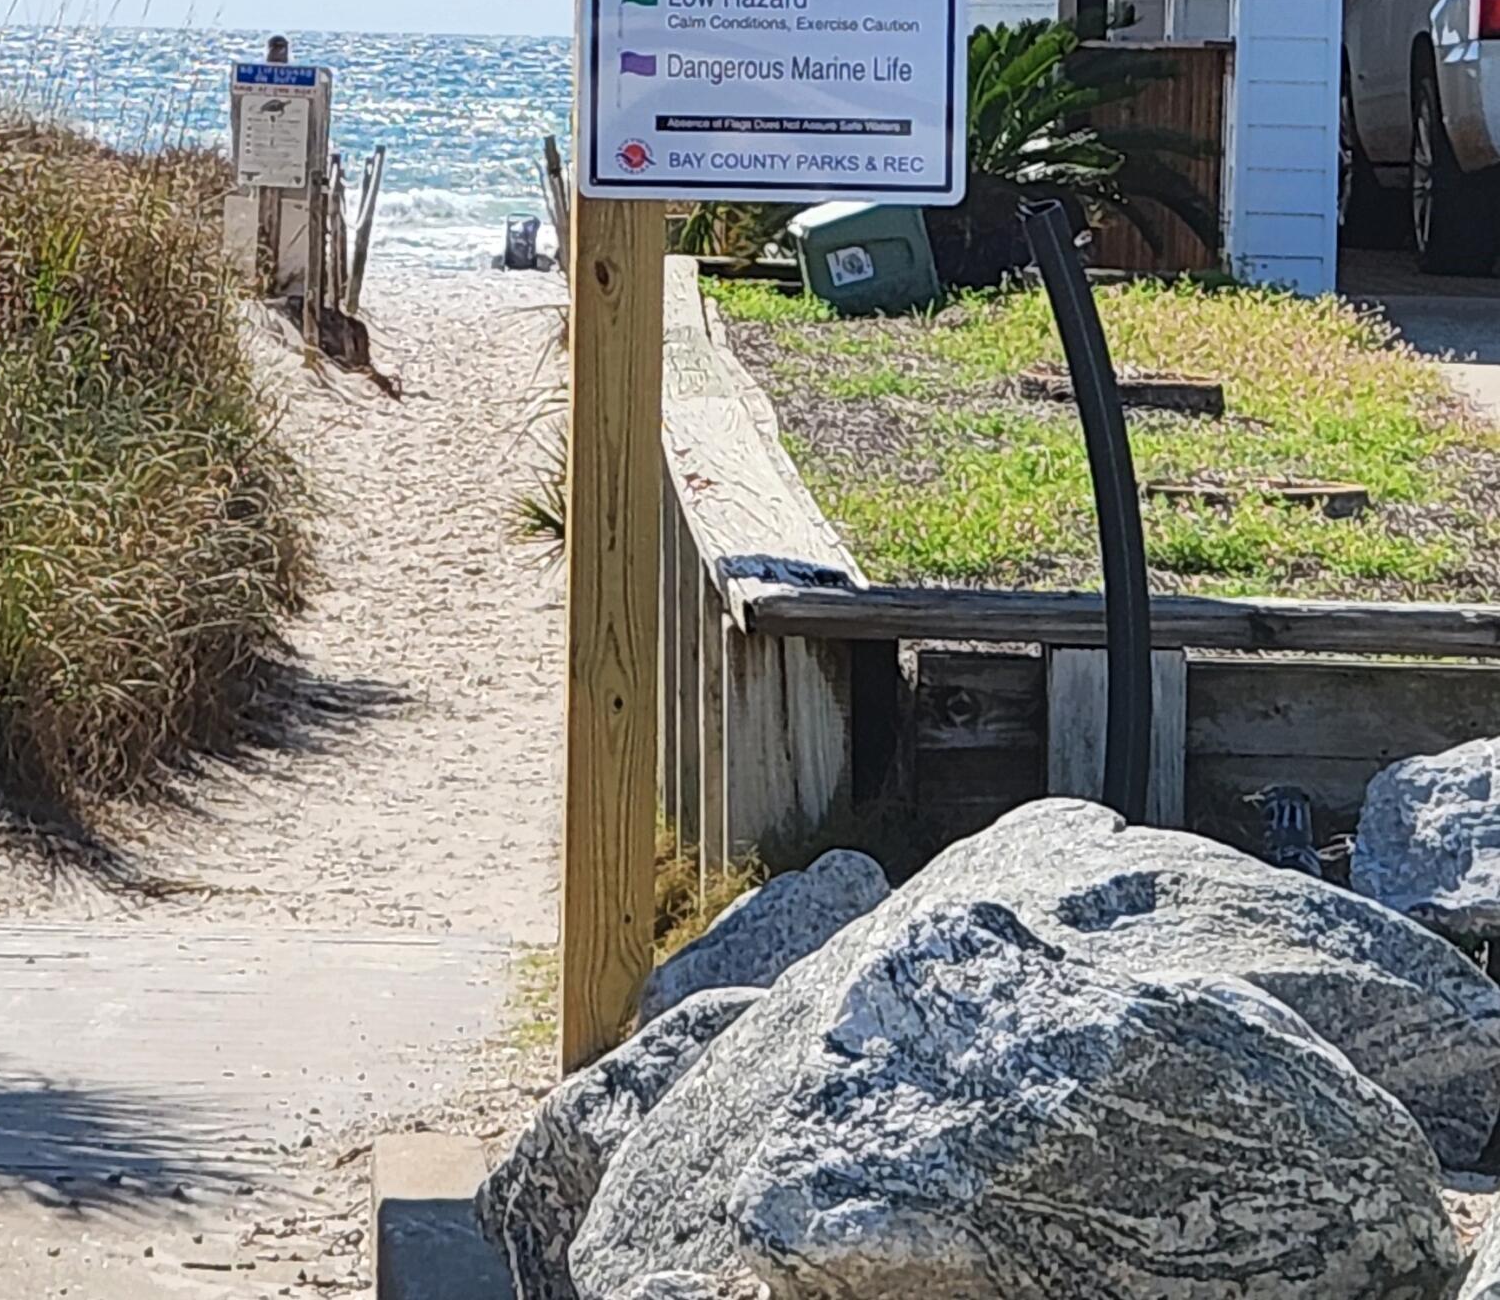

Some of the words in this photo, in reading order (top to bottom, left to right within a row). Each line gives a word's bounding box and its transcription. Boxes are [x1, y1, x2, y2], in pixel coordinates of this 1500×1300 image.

[667, 14, 706, 29] Calm
[709, 15, 791, 32] Conditions,
[796, 16, 859, 32] Exercise
[862, 17, 920, 32] Caution
[667, 54, 785, 85] Dangerous
[791, 56, 866, 81] Marine
[873, 57, 912, 82] Life
[667, 117, 710, 129] Absence
[712, 118, 722, 129] of
[724, 118, 751, 132] Flags
[754, 120, 781, 131] Does
[783, 119, 801, 130] Not
[839, 120, 863, 132] Safe
[668, 152, 705, 169] BAY
[710, 152, 791, 170] COUNTY
[797, 154, 860, 171] PARKS
[864, 155, 878, 171] &
[884, 156, 925, 173] REC
